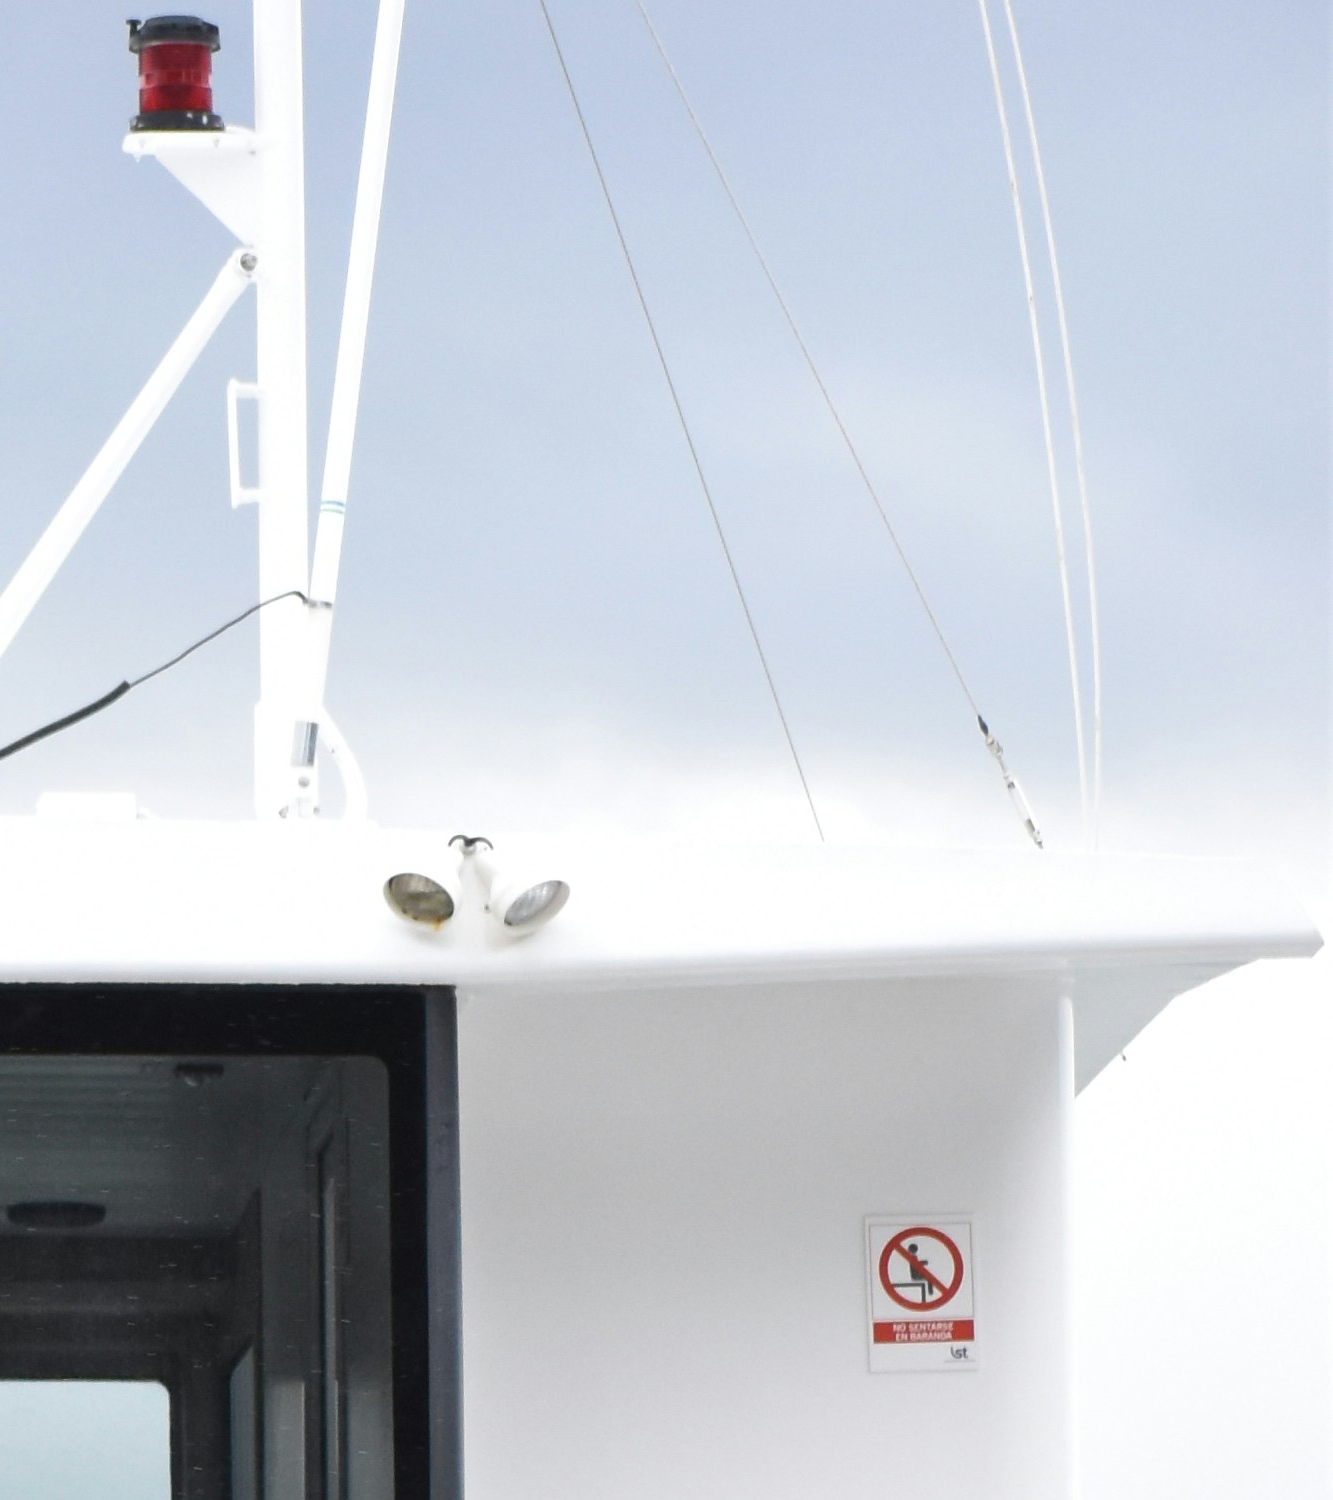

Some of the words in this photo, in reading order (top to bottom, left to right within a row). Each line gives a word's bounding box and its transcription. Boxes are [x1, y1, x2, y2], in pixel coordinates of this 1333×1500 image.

[893, 1323, 906, 1332] NO
[908, 1321, 954, 1332] SENTARSE
[895, 1332, 908, 1342] EN
[909, 1331, 953, 1341] BARANDA
